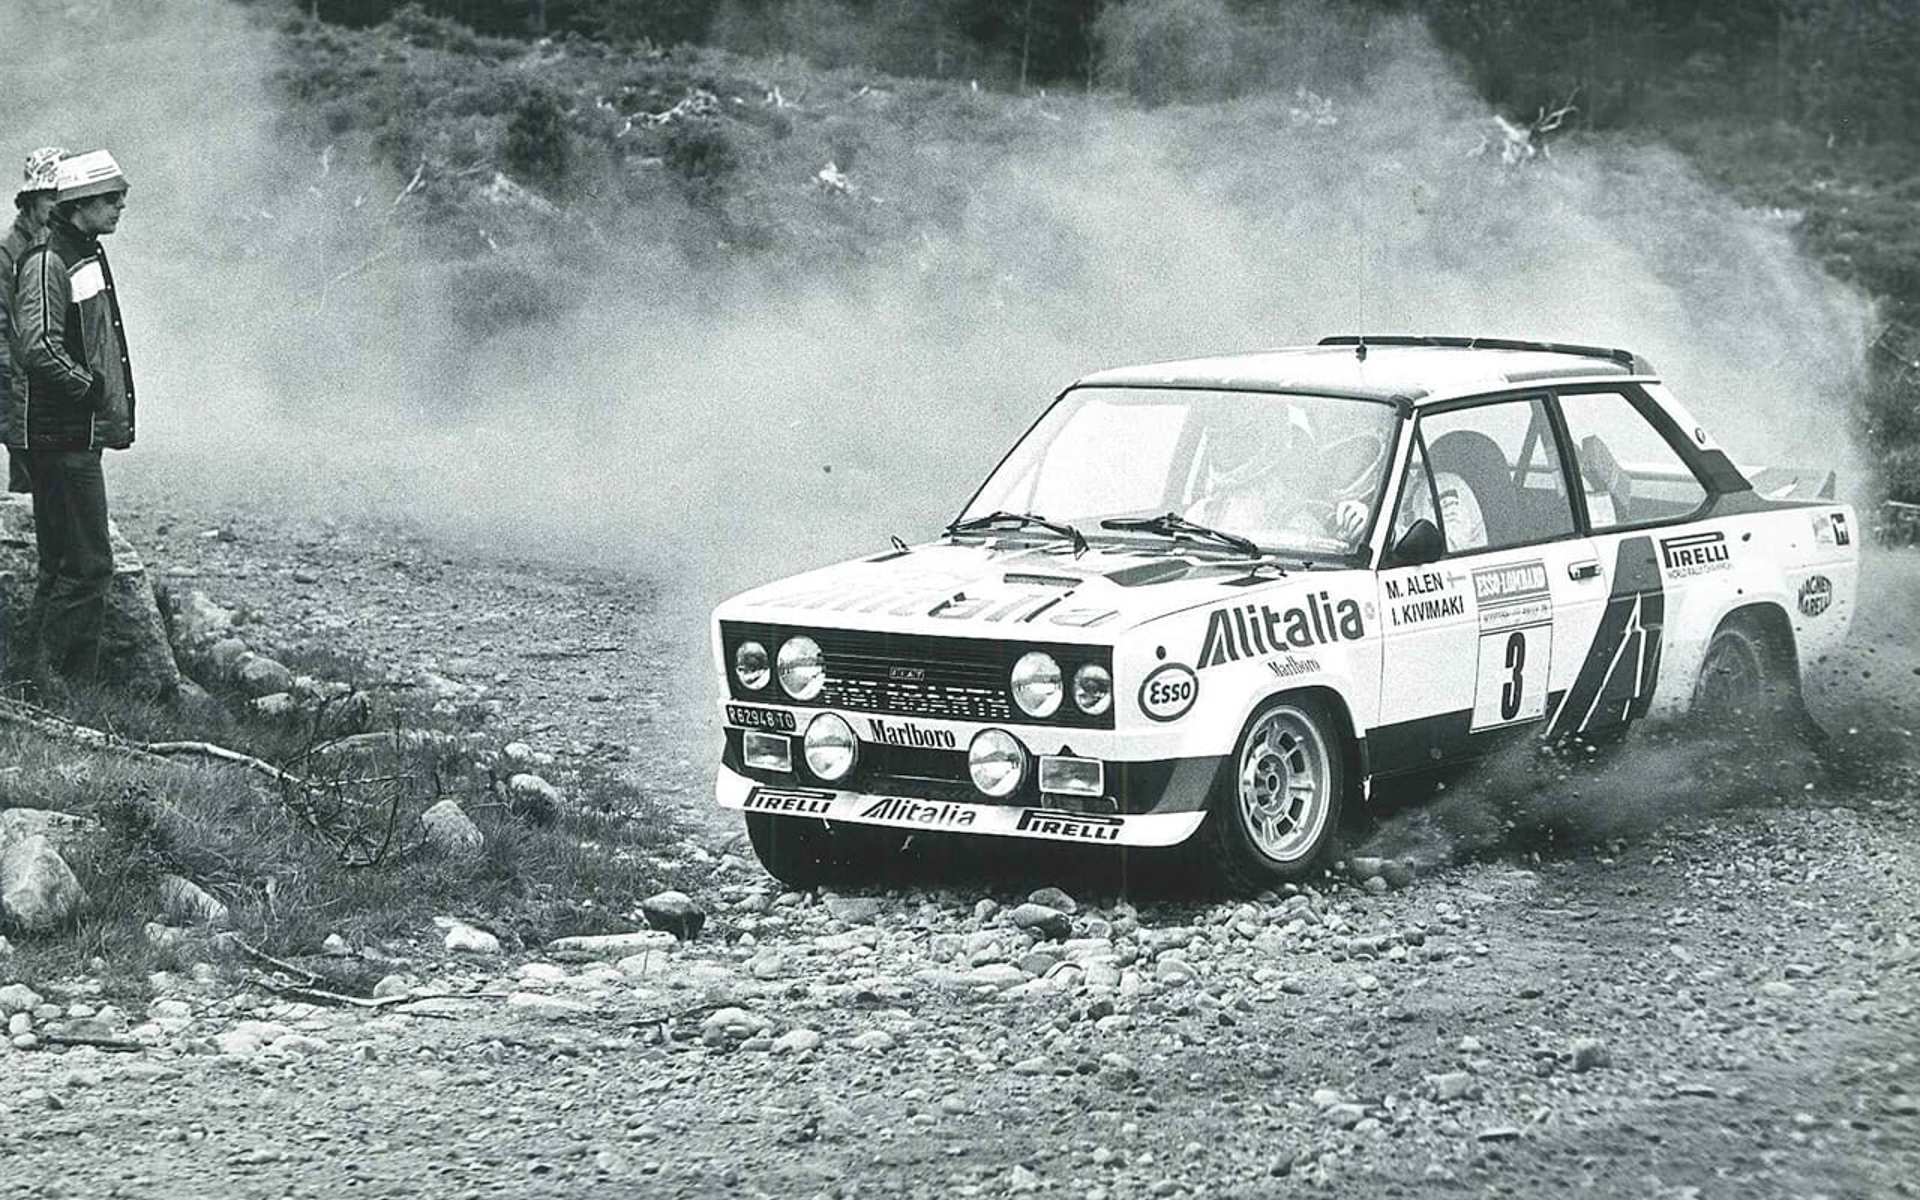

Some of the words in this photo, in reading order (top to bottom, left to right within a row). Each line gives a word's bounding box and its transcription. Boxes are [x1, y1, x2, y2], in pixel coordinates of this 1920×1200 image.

[1660, 531, 1729, 568] PIRELLI
[1386, 580, 1404, 599] M.
[1407, 572, 1444, 596] ALEN
[1391, 607, 1401, 626] I.
[1402, 595, 1464, 624] KIVIMAKI
[1197, 591, 1365, 670] Alitalia
[1267, 655, 1321, 678] Marlboro
[1501, 632, 1525, 721] 3
[867, 719, 956, 748] Marlboro
[744, 786, 837, 814] PIRELLI
[860, 798, 977, 826] Alitalia
[1016, 809, 1125, 841] PIRELLI
